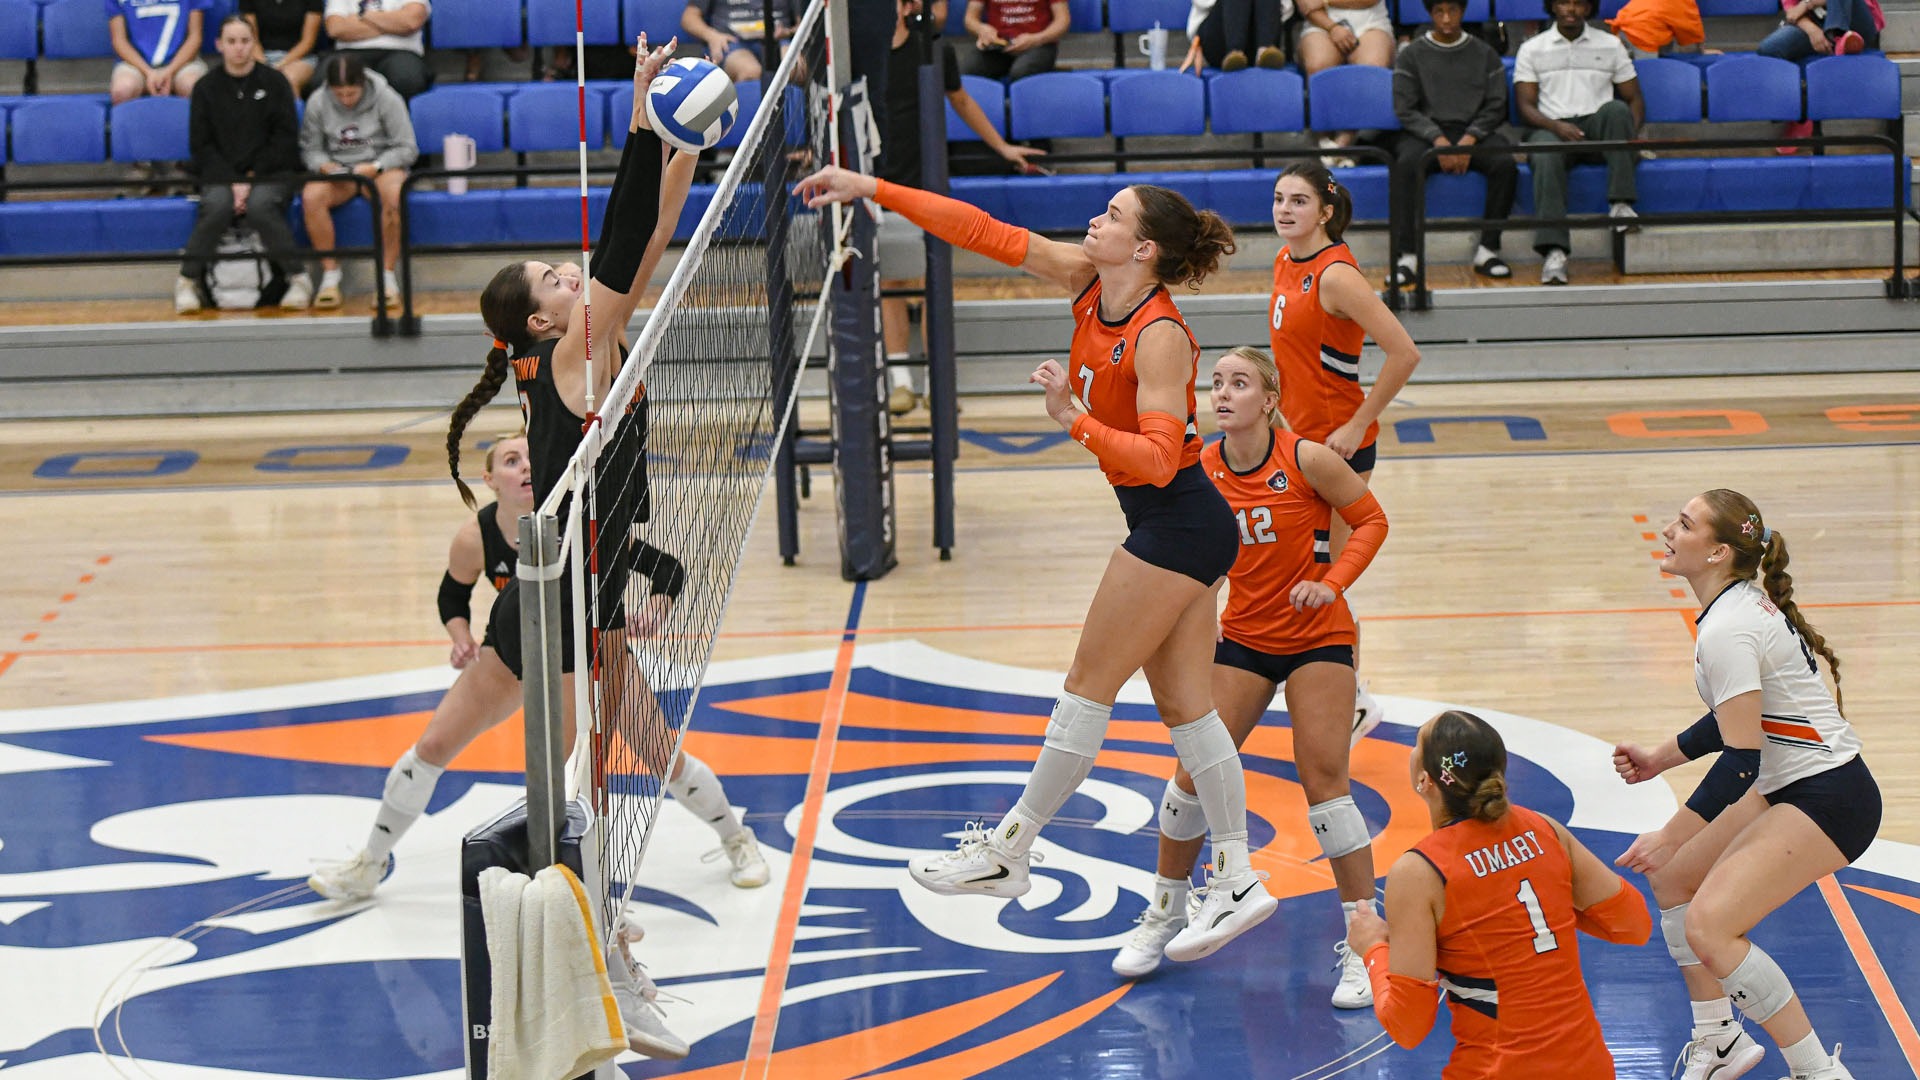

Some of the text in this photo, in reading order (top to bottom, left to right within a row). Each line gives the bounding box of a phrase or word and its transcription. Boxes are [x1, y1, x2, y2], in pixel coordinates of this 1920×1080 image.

[136, 4, 180, 66] 7
[1272, 294, 1287, 331] 6
[1078, 363, 1095, 412] 7
[1235, 506, 1278, 545] 12
[1464, 830, 1545, 878] UMARY
[1515, 877, 1559, 954] 1
